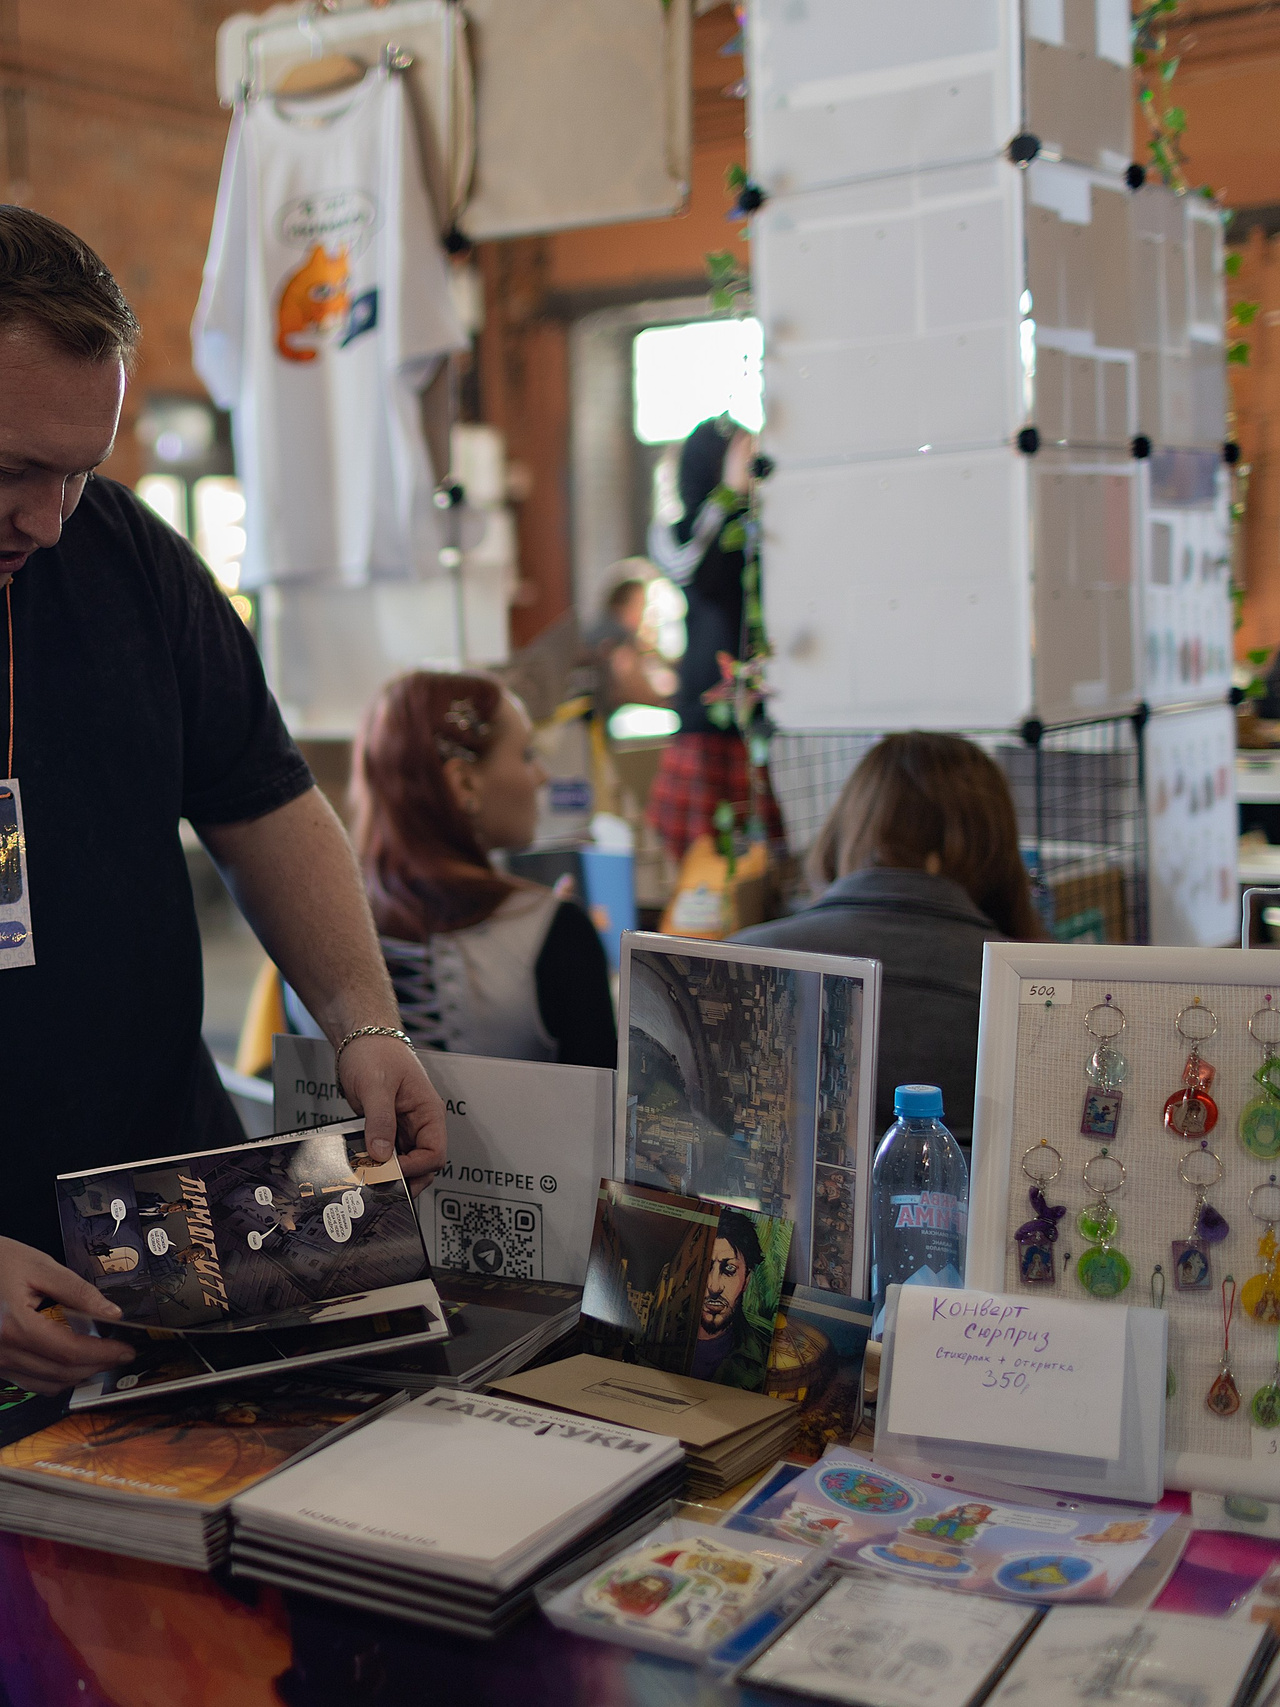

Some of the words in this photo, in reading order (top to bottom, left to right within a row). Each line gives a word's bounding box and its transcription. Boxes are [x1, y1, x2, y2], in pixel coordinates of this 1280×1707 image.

[295, 1079, 340, 1101] ПОДП
[296, 1110, 307, 1125] И
[441, 1098, 467, 1116] АС
[458, 1165, 535, 1191] ЛОТЕРЕЕ
[177, 1173, 230, 1313] ПОМОГИТЕ
[932, 1296, 1030, 1324] Конверт
[422, 1395, 652, 1455] ГАЛСТУКИ
[34, 1460, 98, 1479] НОВОЕ
[99, 1474, 180, 1494] НАЧАЛО
[298, 1507, 360, 1530] НОВОЕ
[361, 1524, 438, 1547] НАЧАЛО
